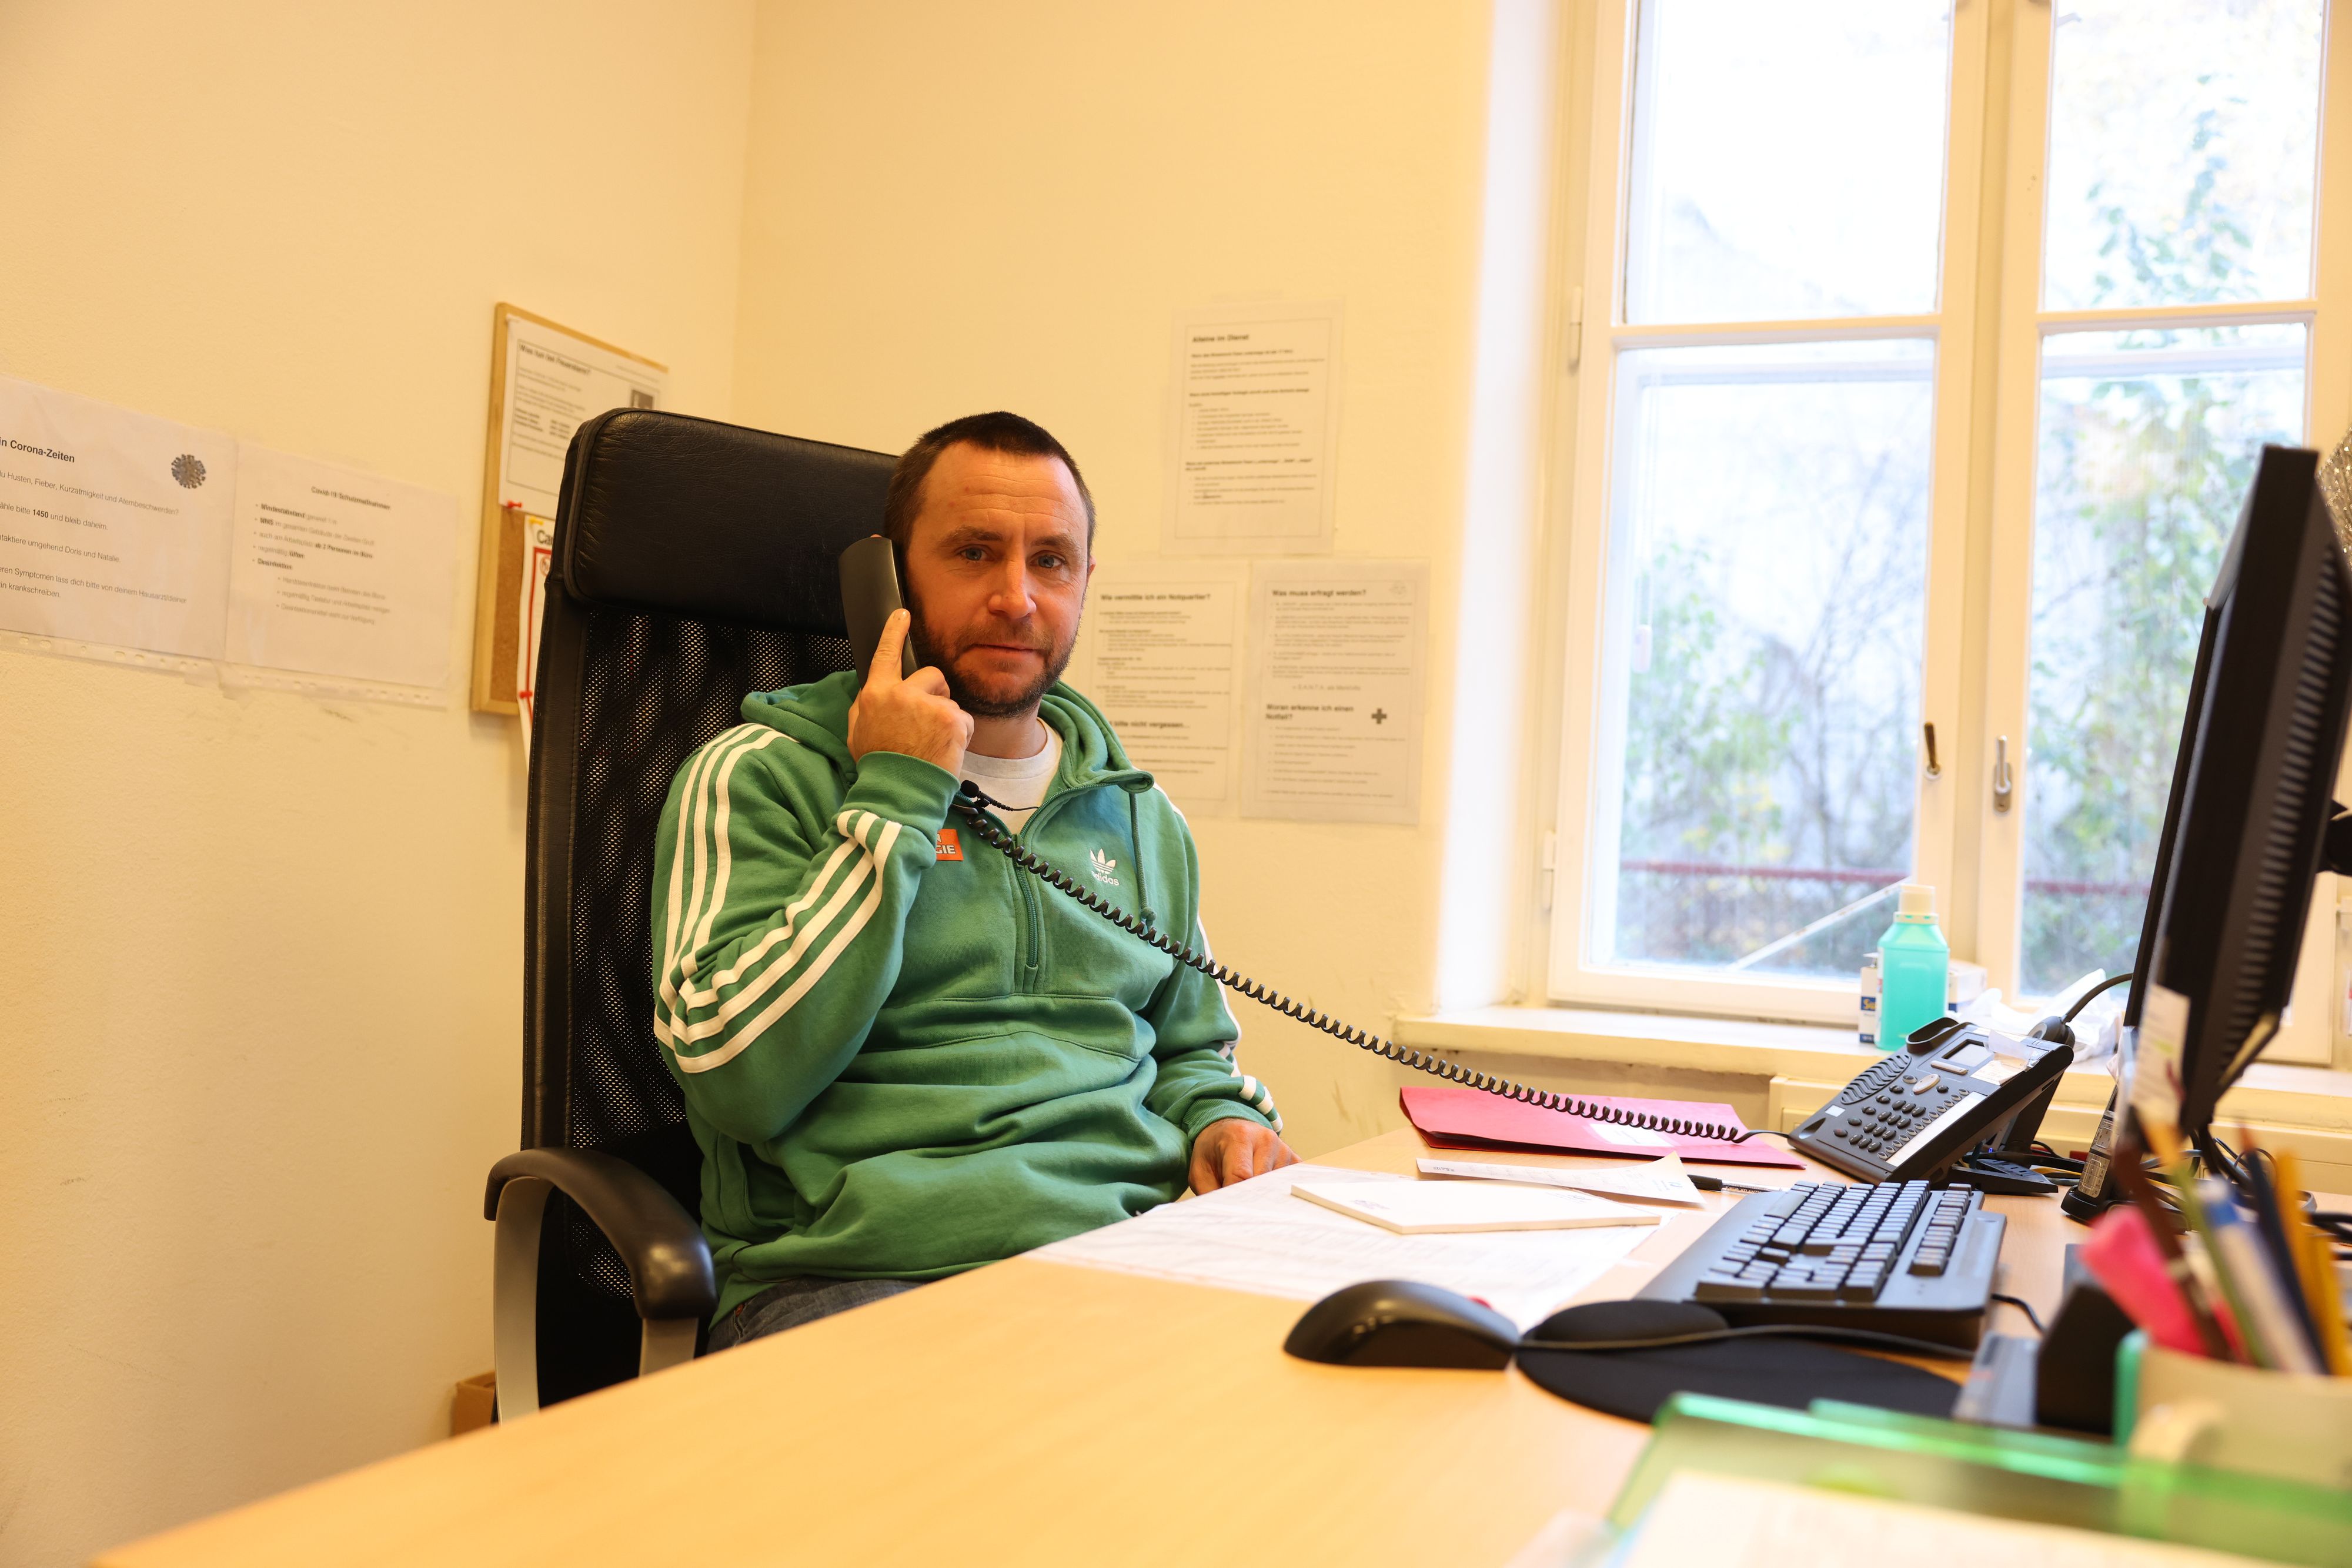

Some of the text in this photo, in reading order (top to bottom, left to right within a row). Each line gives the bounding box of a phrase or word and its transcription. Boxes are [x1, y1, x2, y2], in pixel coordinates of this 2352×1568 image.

[10, 440, 75, 463] Corona-Zeiten
[8, 472, 33, 484] Husten,
[35, 478, 58, 490] Fieber,
[59, 484, 103, 499] Kurzatmigkeit
[16, 505, 31, 515] bitte
[33, 509, 49, 519] 1450
[65, 517, 81, 525] bleib
[83, 519, 108, 530] daheim.
[28, 540, 64, 552] umgehend
[65, 546, 82, 556] Doris
[15, 568, 54, 581] Symptomen
[56, 576, 69, 584] lass
[70, 579, 84, 587] dich
[86, 580, 100, 589] bitte
[9, 583, 61, 598] krankschreiben.
